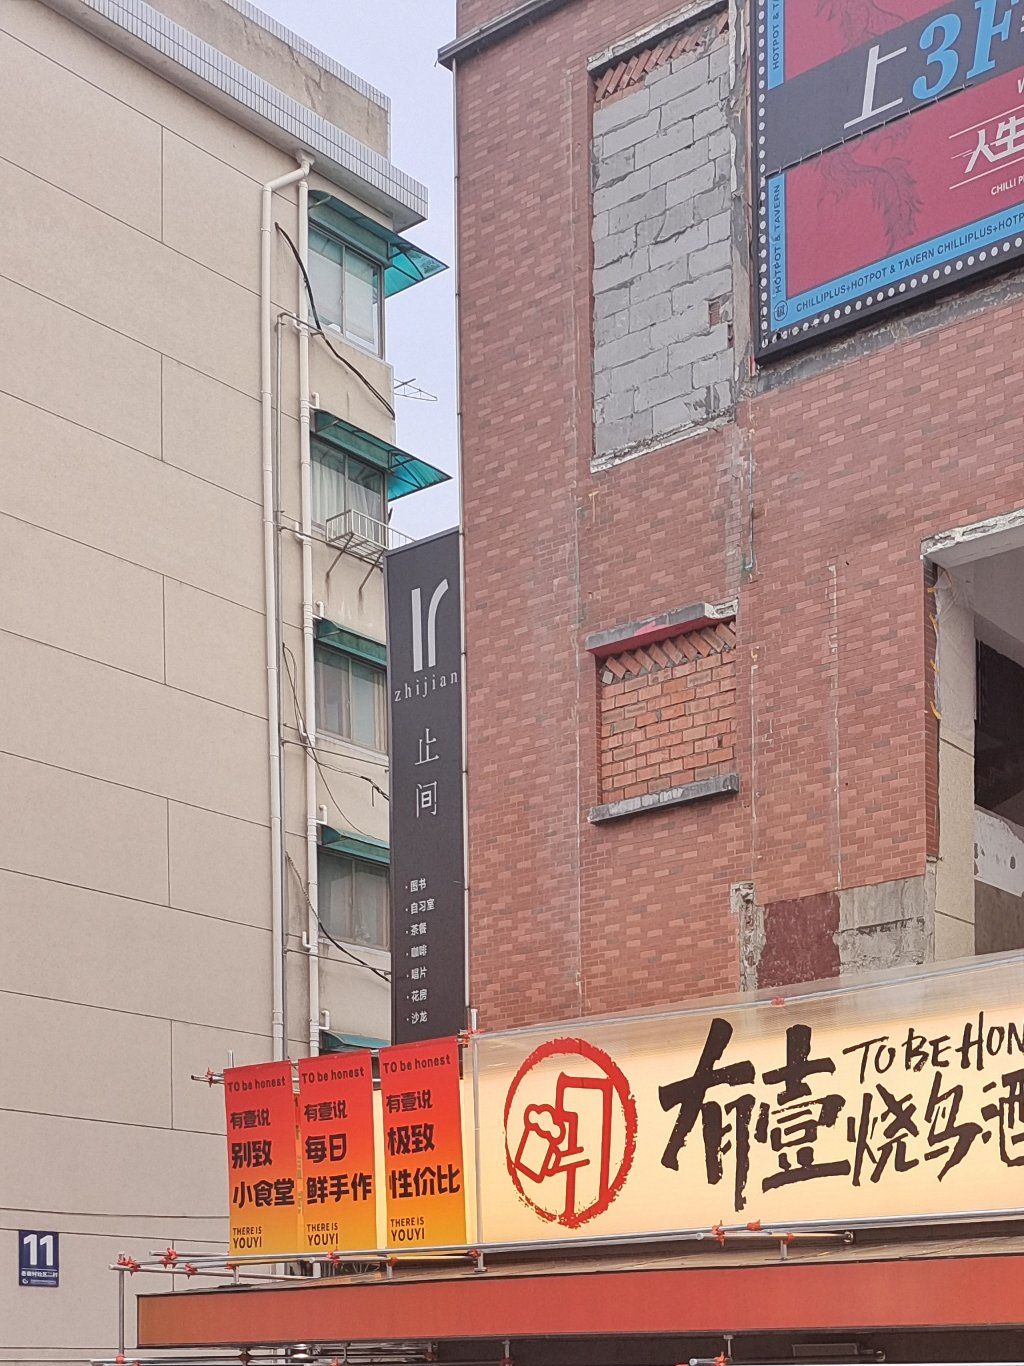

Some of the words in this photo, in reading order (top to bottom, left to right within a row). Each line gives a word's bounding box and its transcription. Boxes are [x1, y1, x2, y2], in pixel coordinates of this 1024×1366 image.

[772, 24, 780, 70] HOTPOT
[991, 177, 1017, 196] CHILLI
[774, 247, 782, 293] HOTPOT
[890, 263, 896, 274] &
[899, 249, 934, 271] TAVERN
[394, 671, 459, 702] zhijian
[415, 728, 439, 818] 止间
[410, 878, 427, 892] 图书
[410, 898, 435, 914] 自习室
[411, 966, 427, 980] 唱片
[411, 1011, 427, 1024] 沙龙
[383, 1061, 398, 1074] TO
[400, 1059, 413, 1071] be
[415, 1054, 450, 1069] honest
[843, 1036, 896, 1083] TO
[904, 1029, 955, 1072] BE
[228, 1082, 240, 1092] TO
[242, 1080, 253, 1091] be
[255, 1076, 286, 1089] honest
[302, 1072, 315, 1084] TO
[318, 1070, 328, 1082] be
[331, 1067, 364, 1080] honest
[304, 1100, 347, 1122] 有壹说
[386, 1089, 432, 1114] 有壹说
[230, 1108, 271, 1129] 有壹说
[305, 1133, 347, 1164] 每日
[388, 1122, 435, 1156] 极致
[231, 1139, 272, 1169] 别致
[306, 1172, 372, 1205] 鲜手作
[389, 1164, 461, 1199] 性价比
[233, 1177, 295, 1208] 小食堂
[233, 1227, 254, 1235] THERE
[255, 1226, 262, 1234] IS
[306, 1223, 329, 1232] THERE
[331, 1222, 338, 1231] IS
[390, 1218, 414, 1227] THERE
[416, 1216, 425, 1226] IS
[233, 1236, 262, 1249] YOUYI
[307, 1232, 339, 1246] YOUYI
[391, 1228, 425, 1241] YOUYI
[24, 1234, 53, 1265] 11
